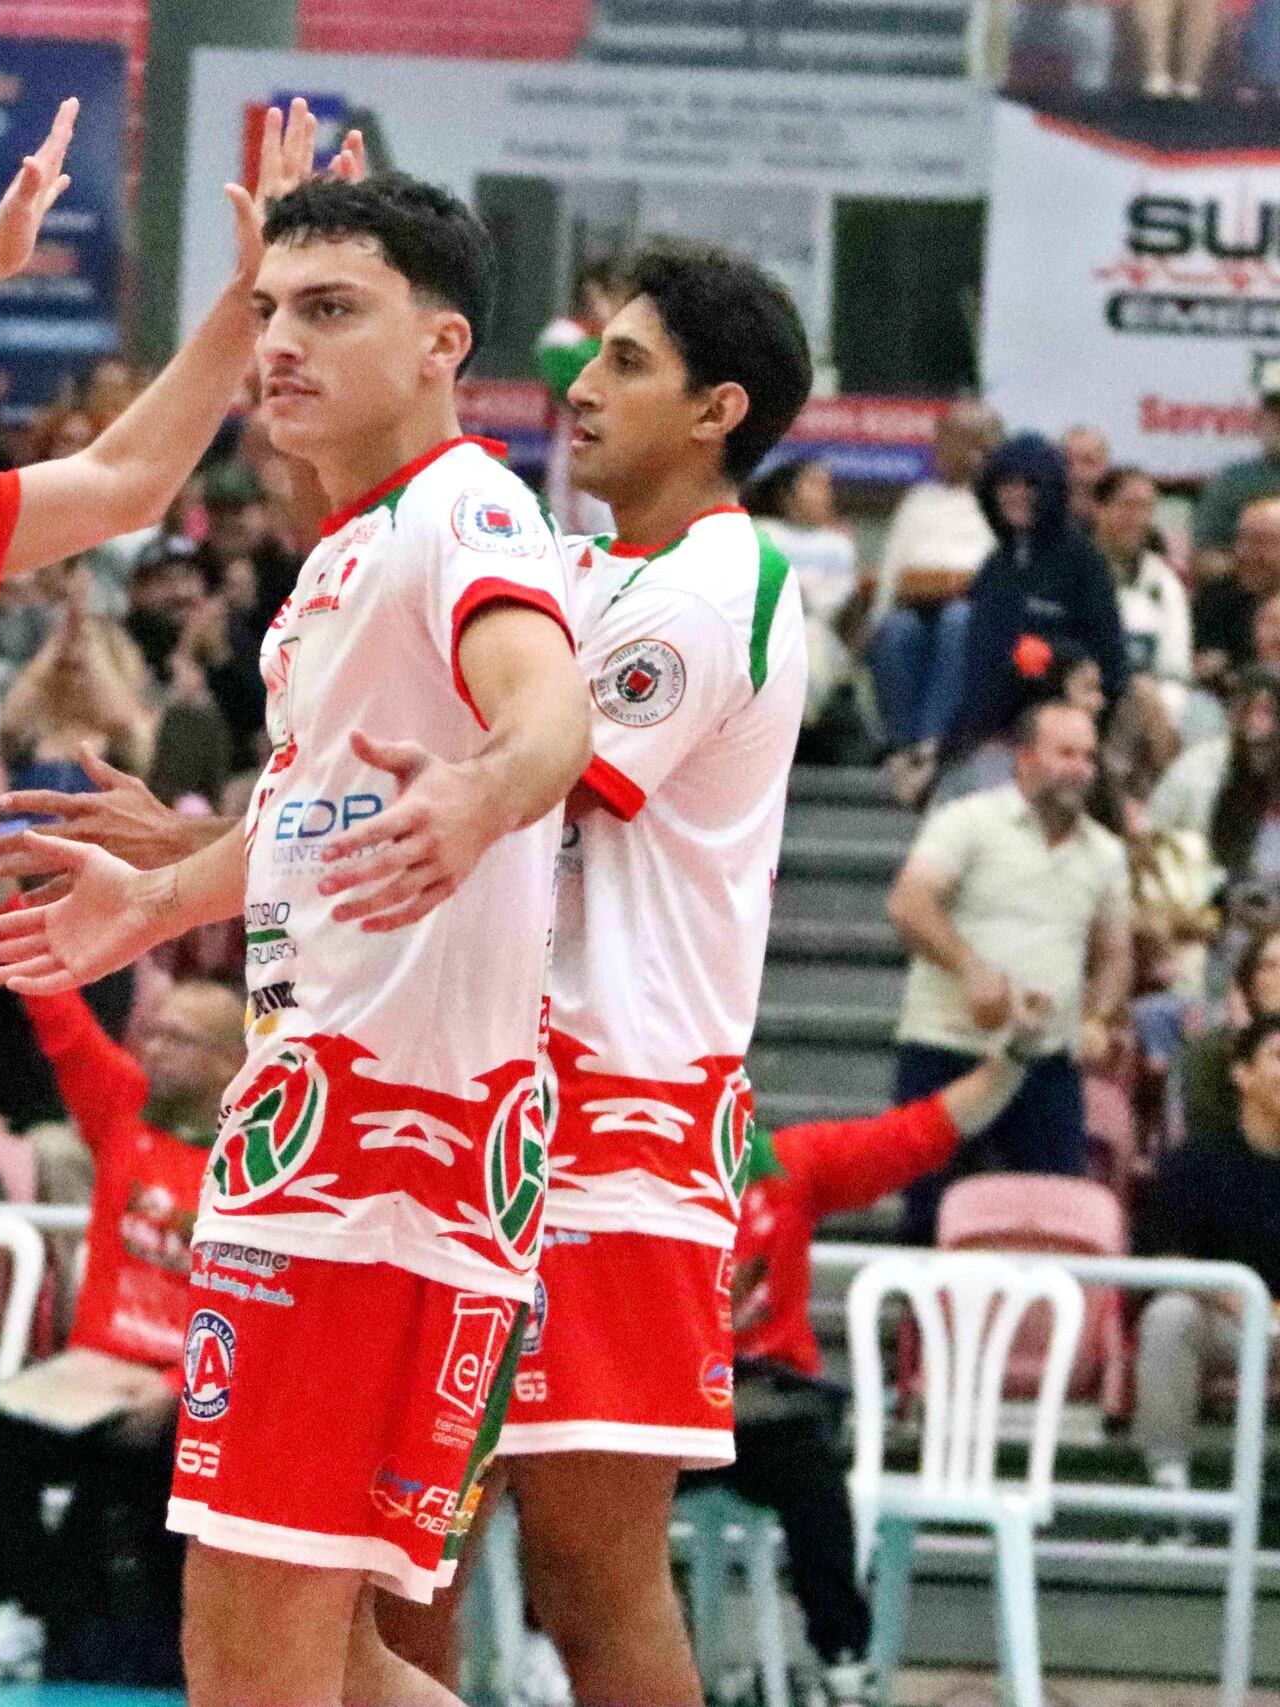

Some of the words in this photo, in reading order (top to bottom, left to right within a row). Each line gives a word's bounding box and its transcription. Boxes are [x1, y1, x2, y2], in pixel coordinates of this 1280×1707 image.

[1127, 195, 1280, 261] SU
[275, 794, 383, 840] EDP
[514, 1370, 549, 1403] 63
[176, 1437, 221, 1480] 63
